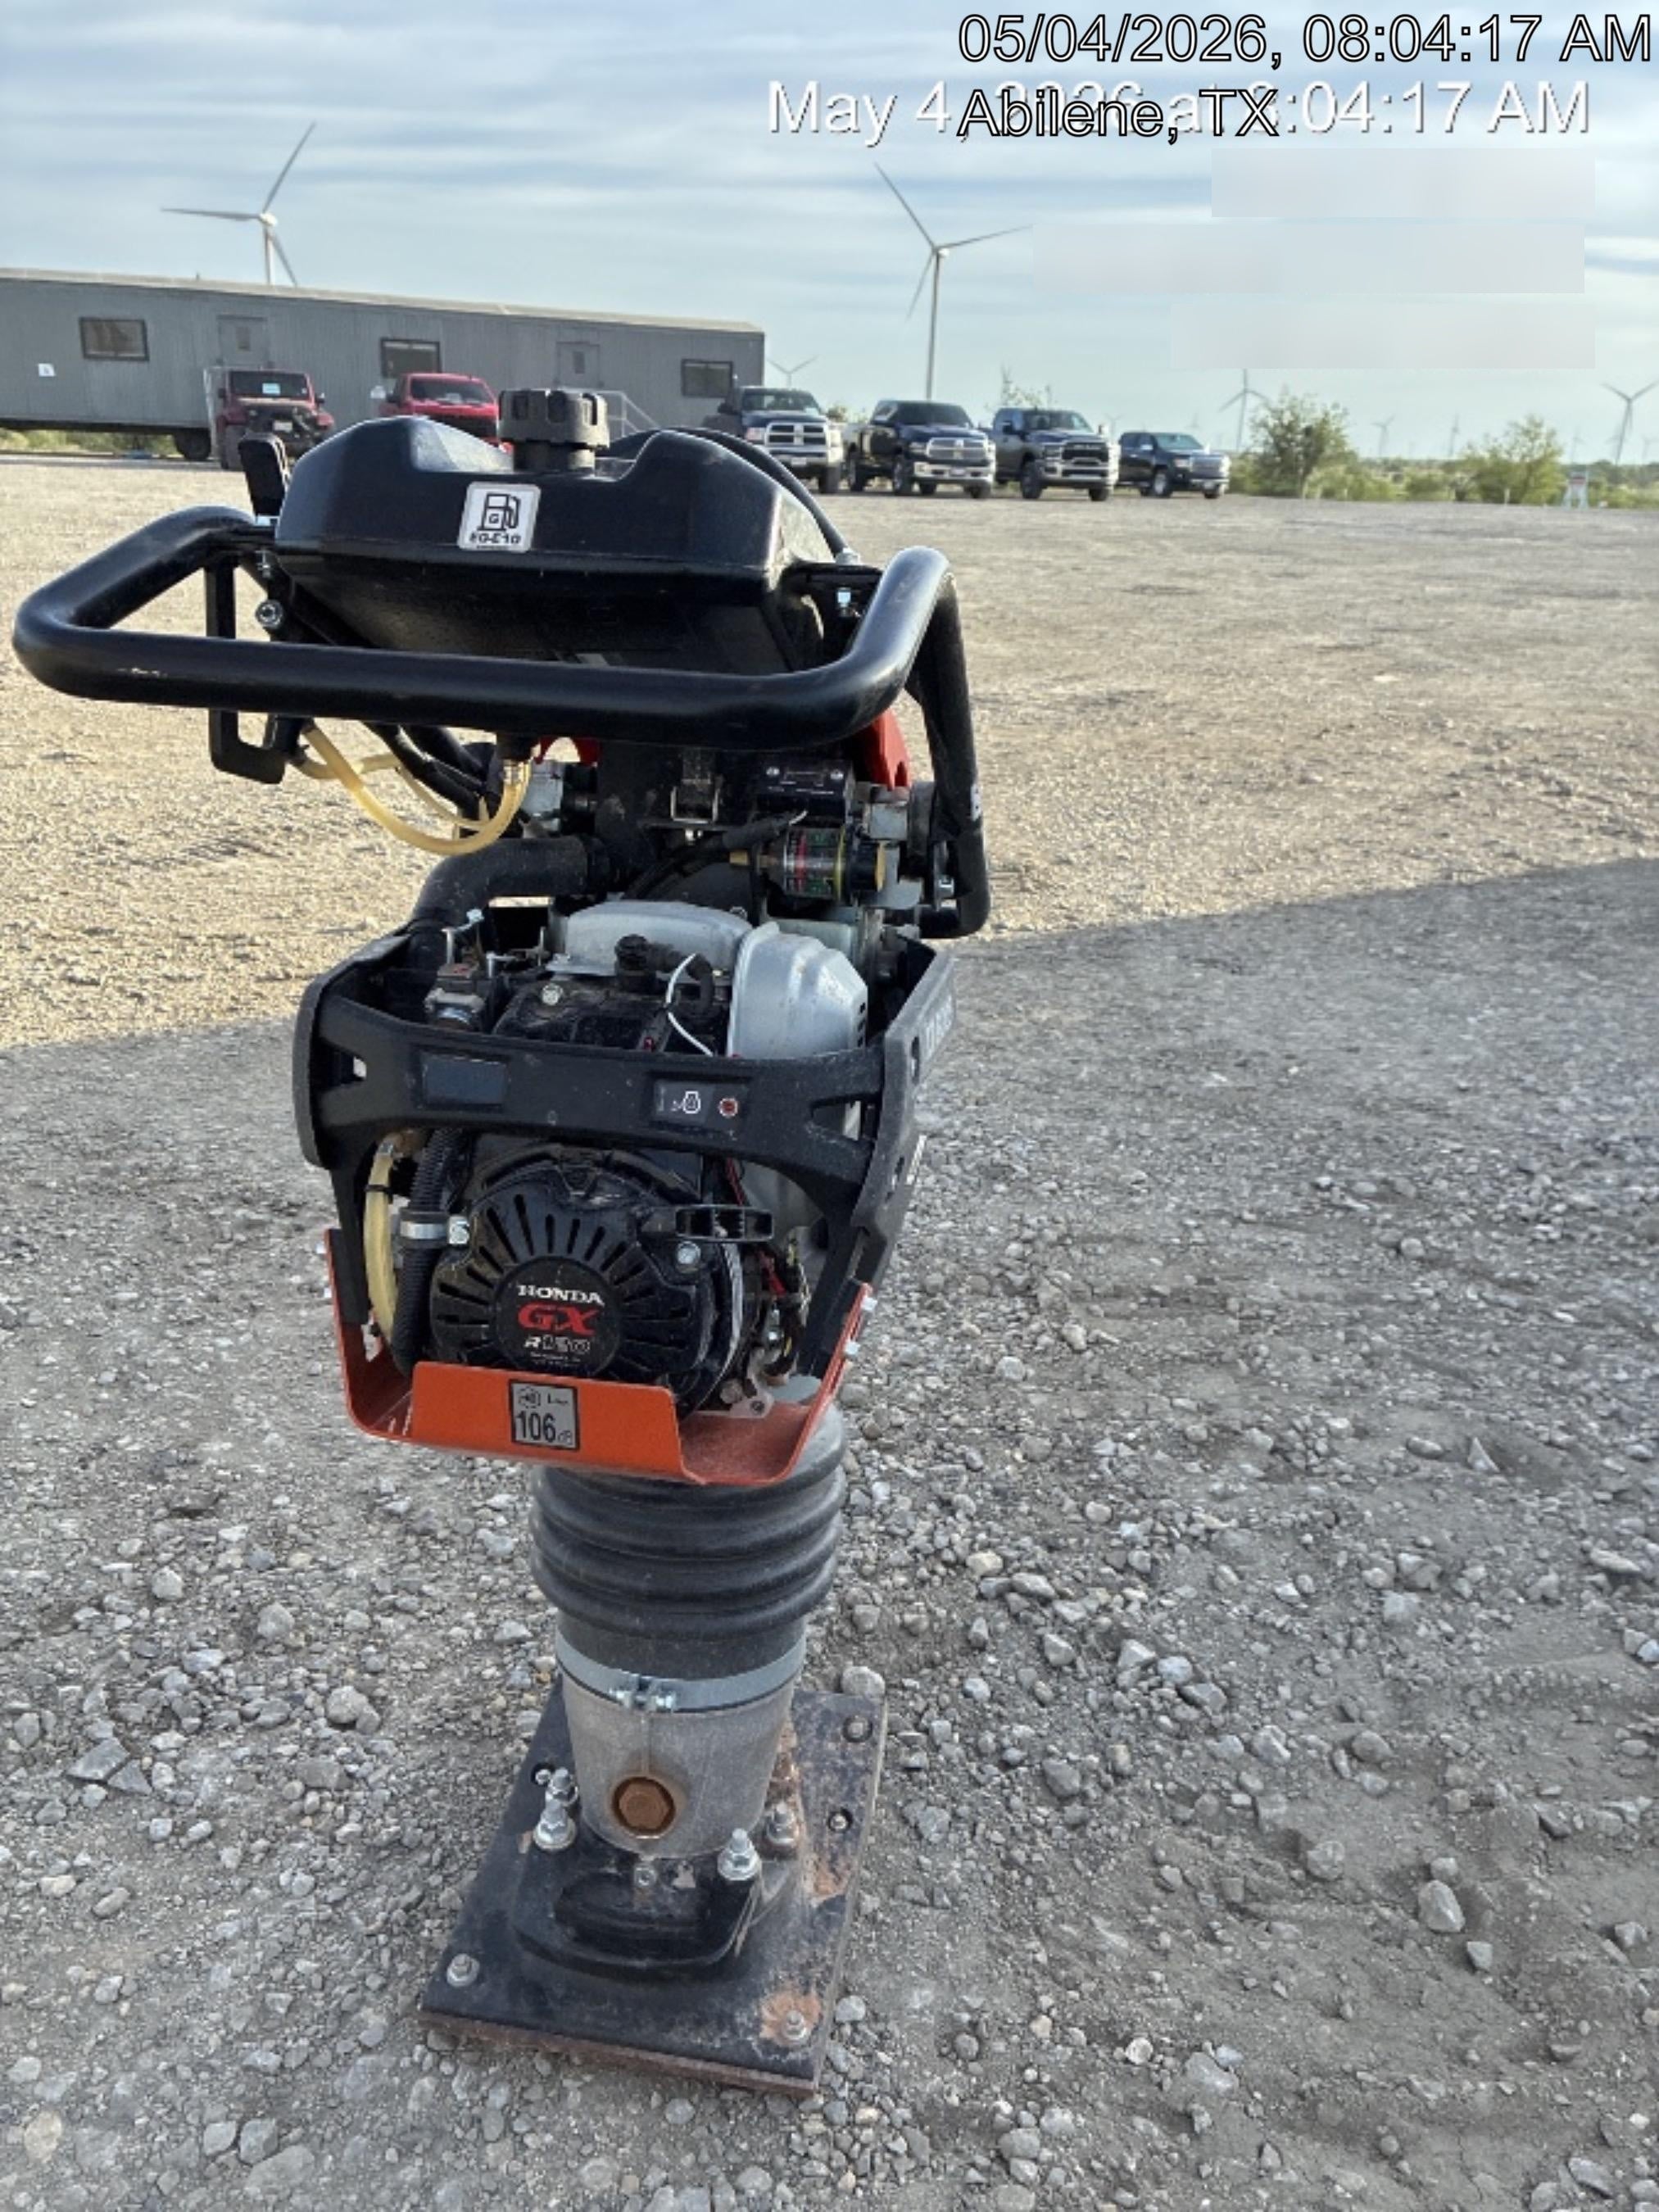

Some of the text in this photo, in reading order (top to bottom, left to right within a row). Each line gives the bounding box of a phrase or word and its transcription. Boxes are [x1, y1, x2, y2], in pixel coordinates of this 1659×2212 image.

[517, 1284, 605, 1307] HONDA
[518, 1301, 600, 1336] GX
[516, 1410, 556, 1443] 106
